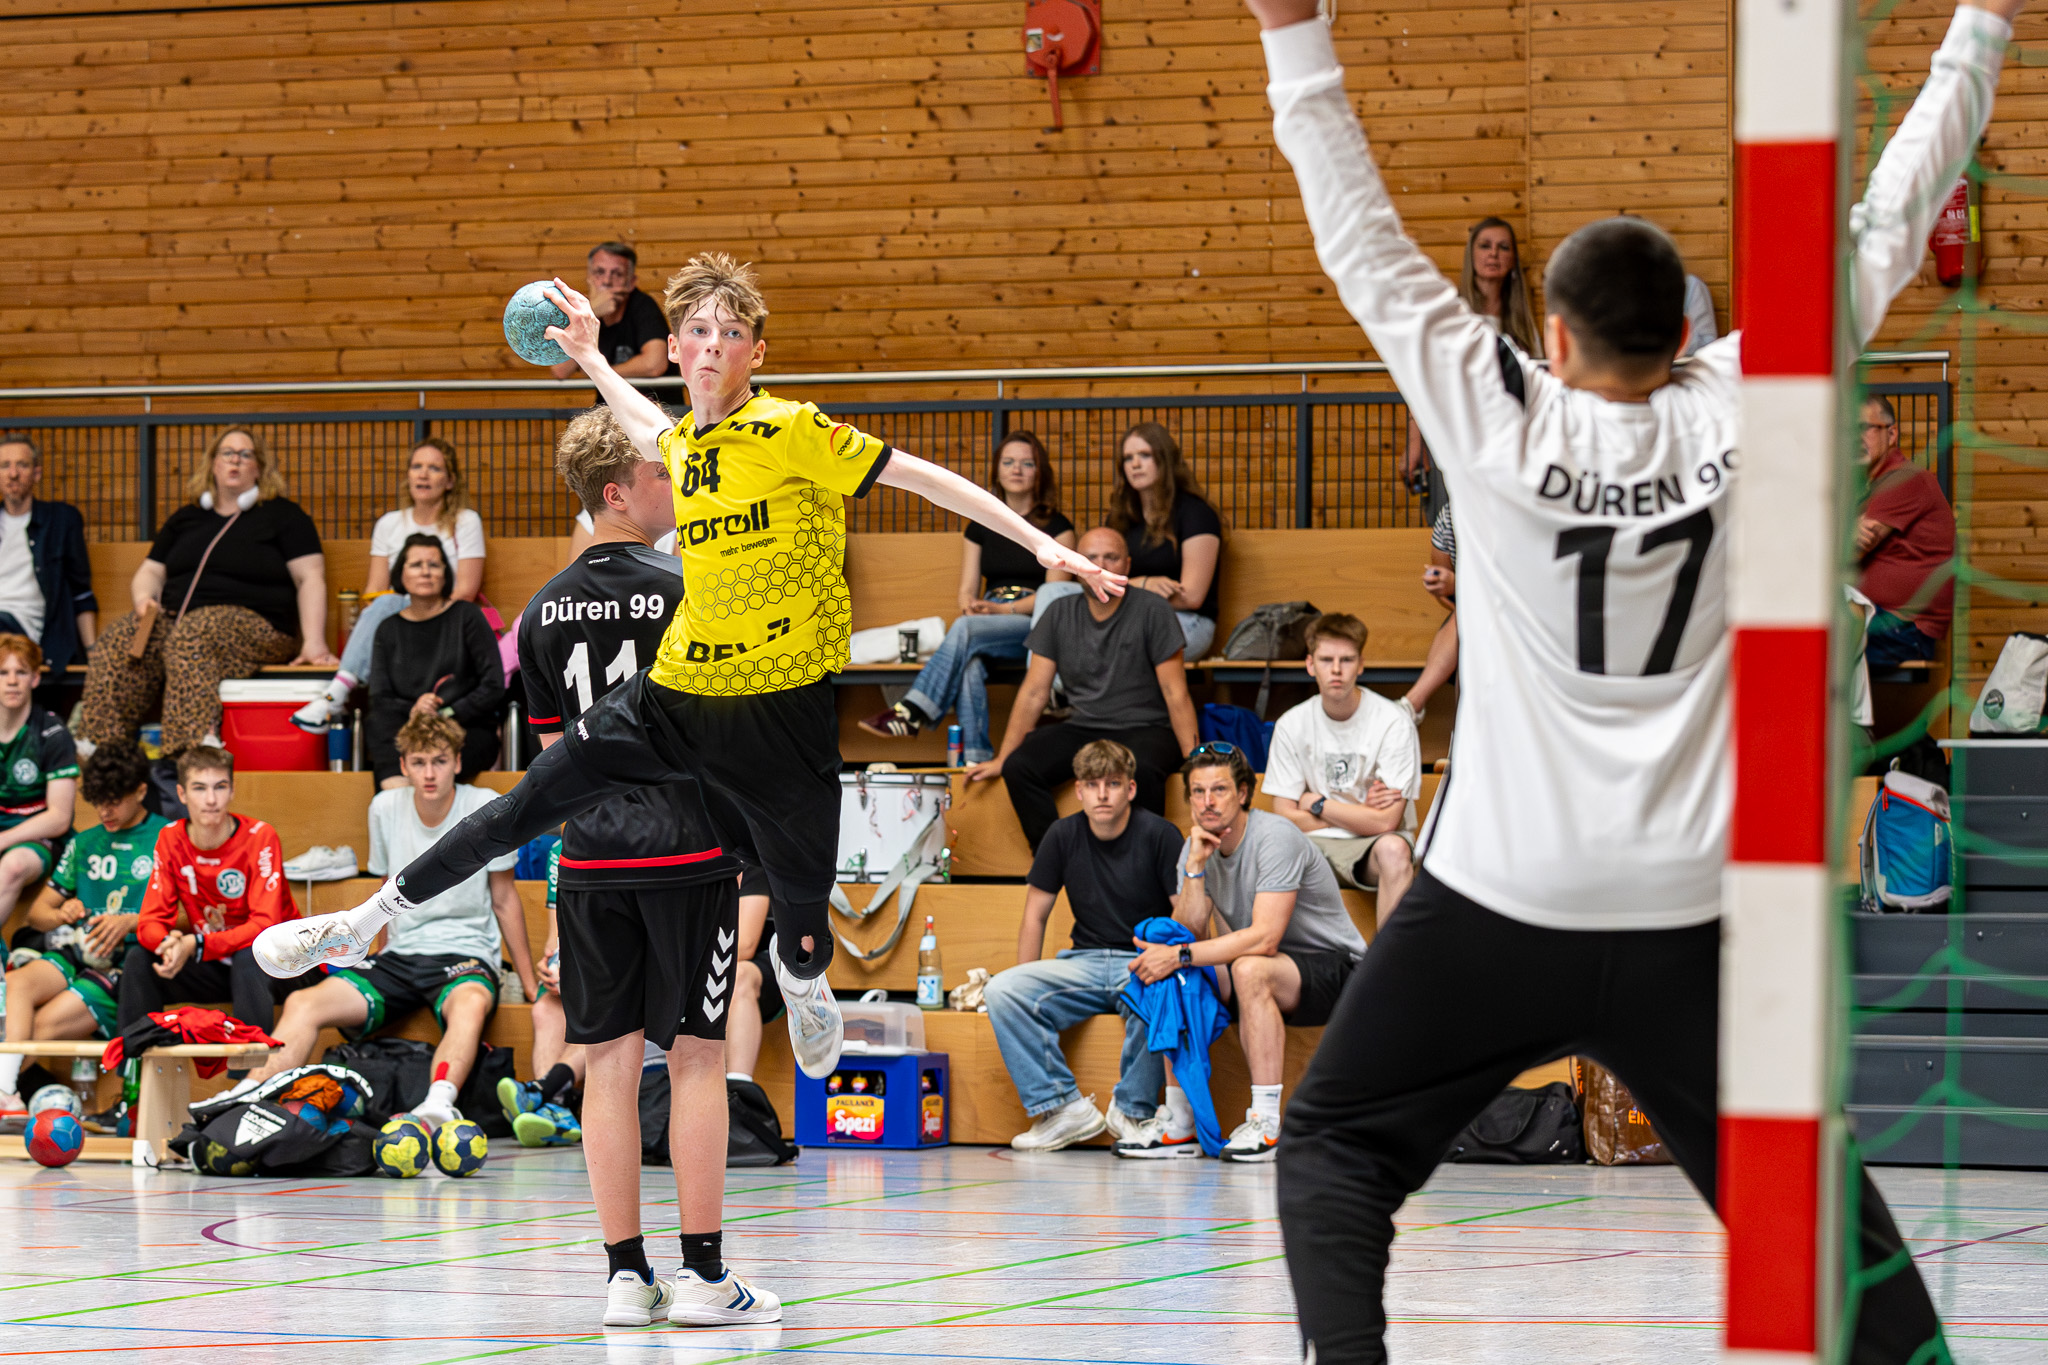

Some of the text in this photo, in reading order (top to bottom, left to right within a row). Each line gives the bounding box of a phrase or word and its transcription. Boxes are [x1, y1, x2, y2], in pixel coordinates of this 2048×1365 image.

[681, 447, 721, 497] 64
[1538, 464, 1687, 516] DÜREN
[720, 536, 778, 558] mehr bewegen
[1553, 507, 1714, 677] 17
[541, 593, 665, 627] Düren 99
[563, 639, 638, 715] 11
[87, 854, 118, 881] 30
[180, 864, 198, 896] 1
[835, 1109, 876, 1136] Spezi
